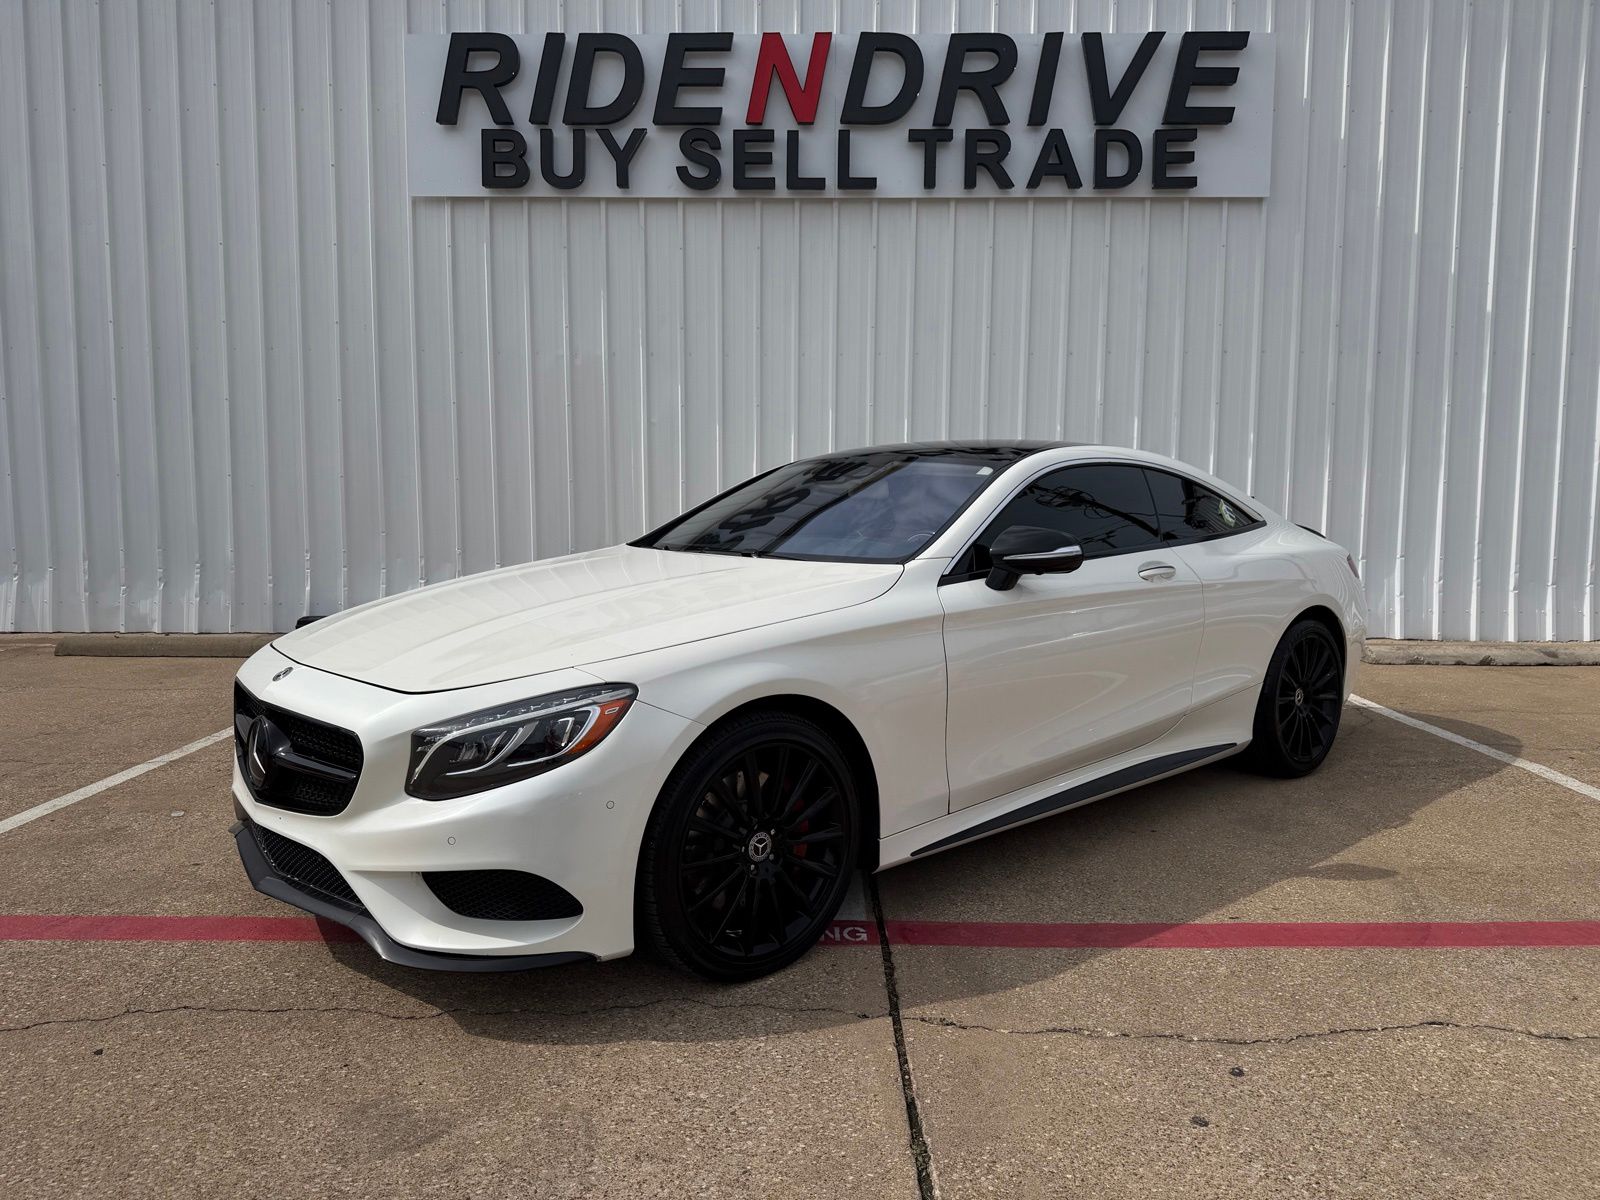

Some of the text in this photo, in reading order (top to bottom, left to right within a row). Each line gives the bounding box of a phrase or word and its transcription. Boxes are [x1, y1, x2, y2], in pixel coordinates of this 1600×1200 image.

[436, 31, 1250, 126] RIDENDRIVE
[481, 127, 1198, 190] BUY SELL TRADE
